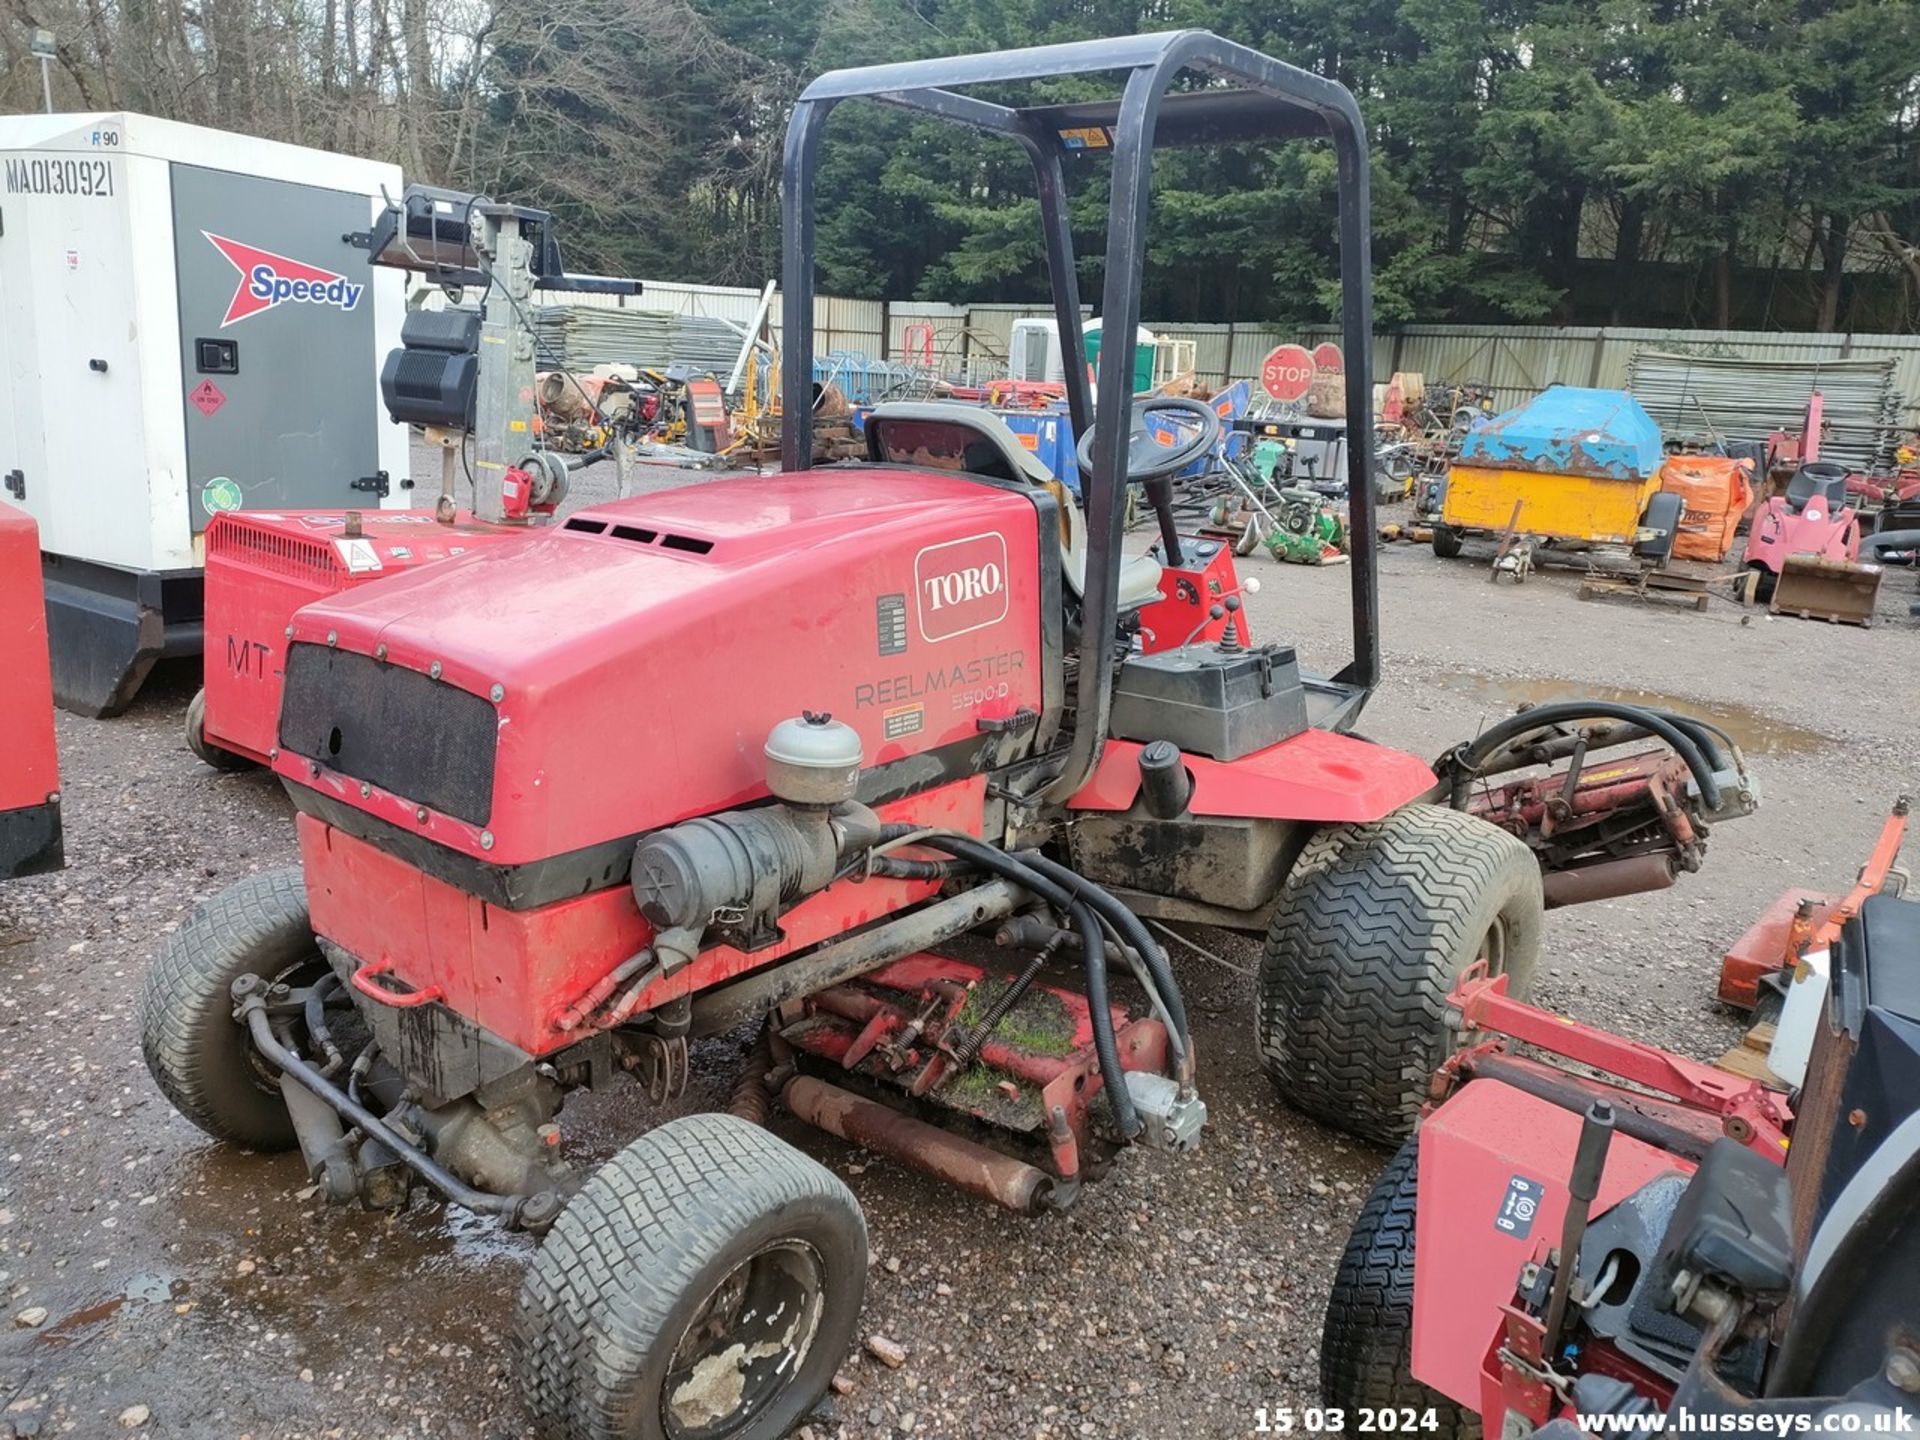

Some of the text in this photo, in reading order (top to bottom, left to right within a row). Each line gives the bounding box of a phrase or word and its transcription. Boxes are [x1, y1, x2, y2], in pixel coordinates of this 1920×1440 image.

[251, 266, 361, 308] Speedy
[1265, 365, 1311, 382] STOP
[855, 650, 1025, 710] REELMASTER
